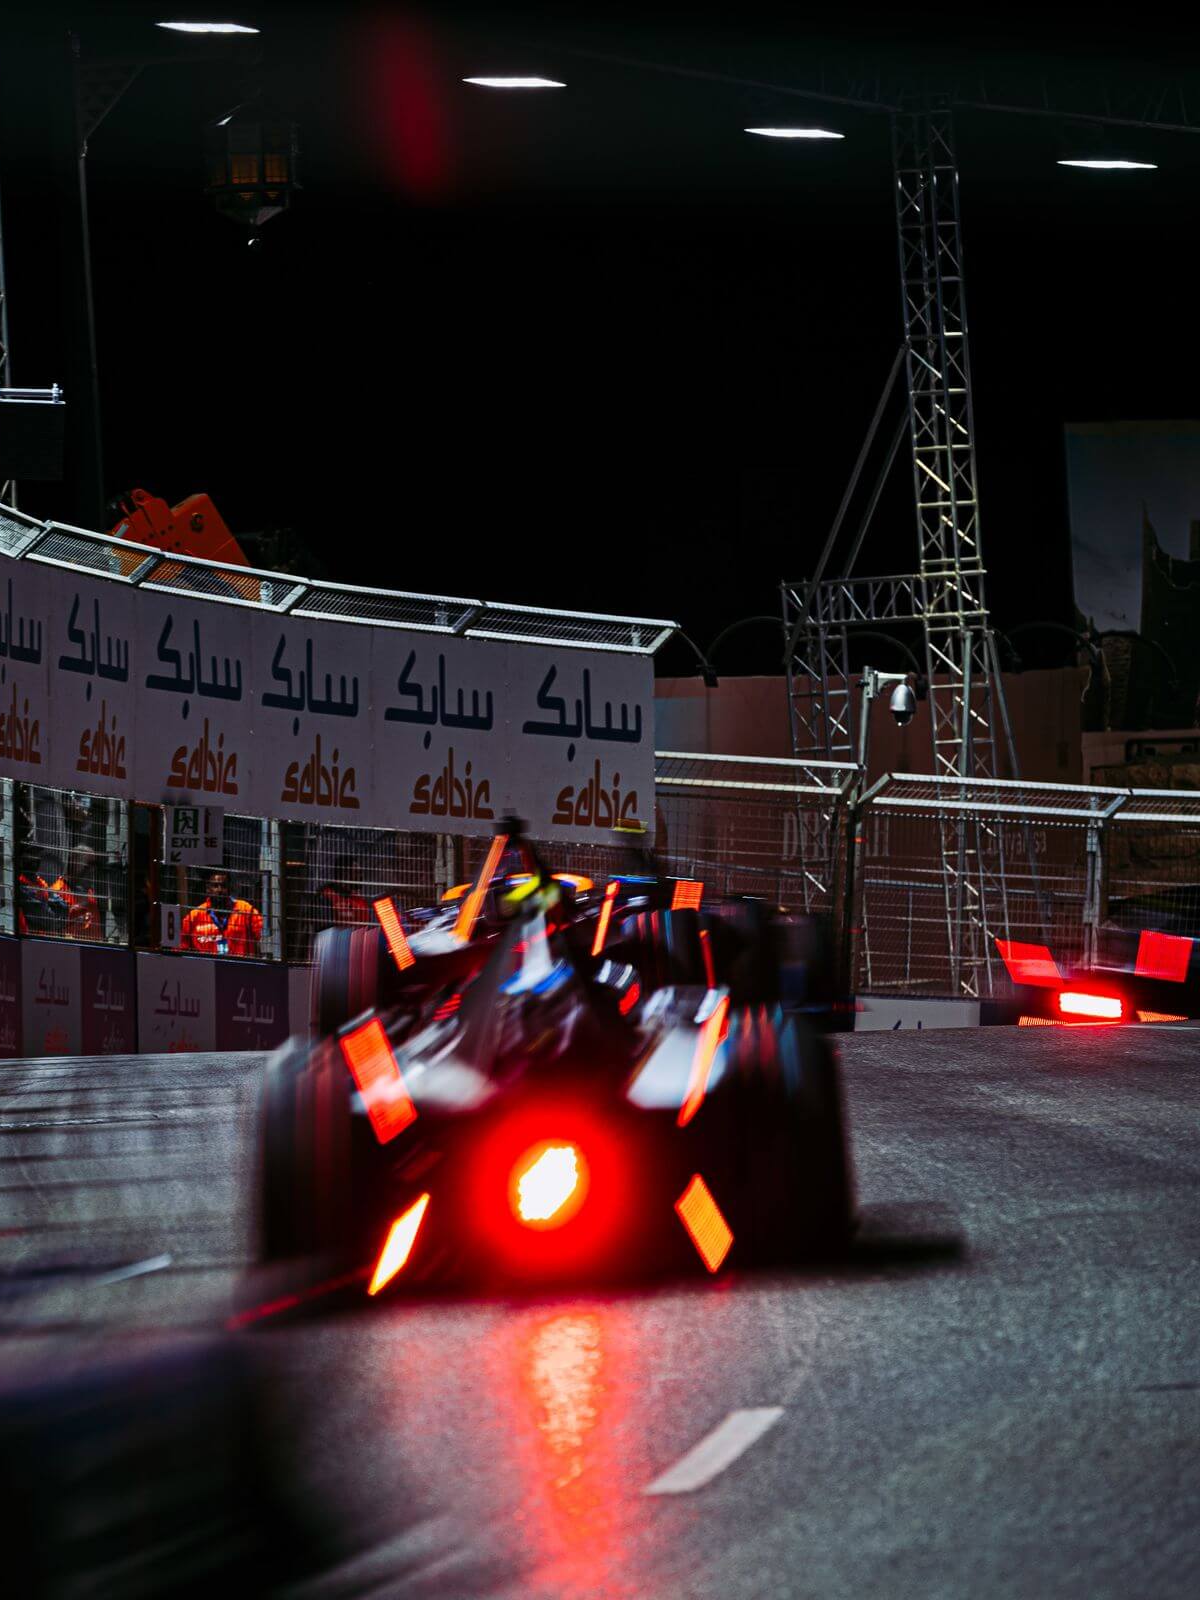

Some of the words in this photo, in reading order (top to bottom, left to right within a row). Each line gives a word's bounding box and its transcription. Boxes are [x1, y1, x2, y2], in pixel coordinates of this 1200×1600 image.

[76, 700, 126, 779] sabic
[166, 718, 238, 795] sabic
[281, 733, 360, 809] sabic
[409, 747, 494, 820] sabic
[552, 758, 641, 829] sabic
[171, 837, 200, 849] EXIT
